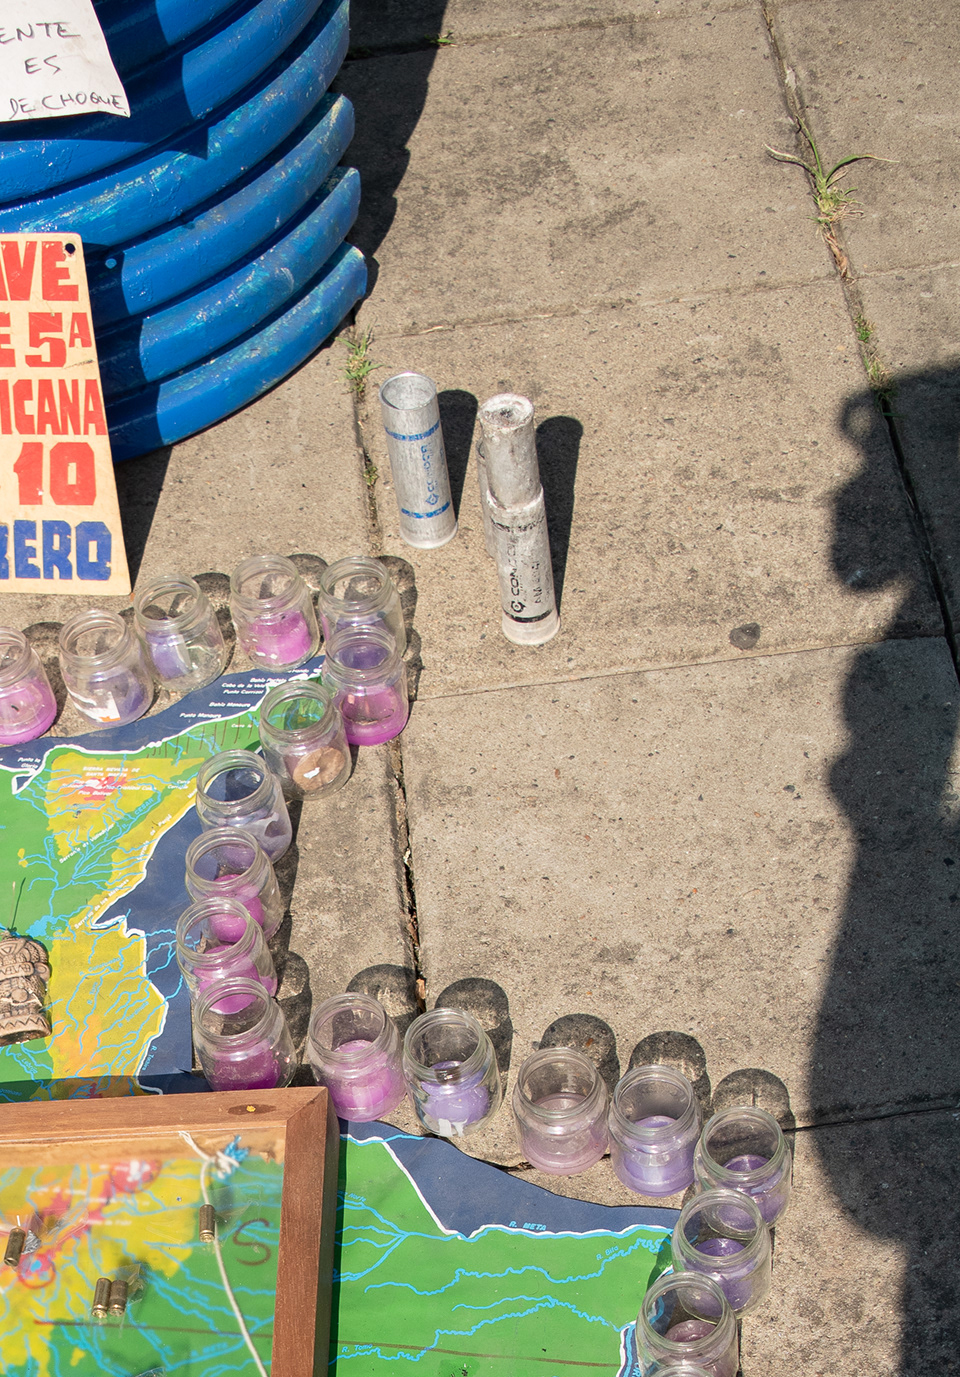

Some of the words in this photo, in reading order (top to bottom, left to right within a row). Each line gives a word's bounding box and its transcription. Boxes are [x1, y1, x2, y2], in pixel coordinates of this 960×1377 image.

[25, 55, 62, 75] ES
[9, 97, 40, 119] DE
[13, 442, 97, 505] 10
[523, 1222, 547, 1231] META
